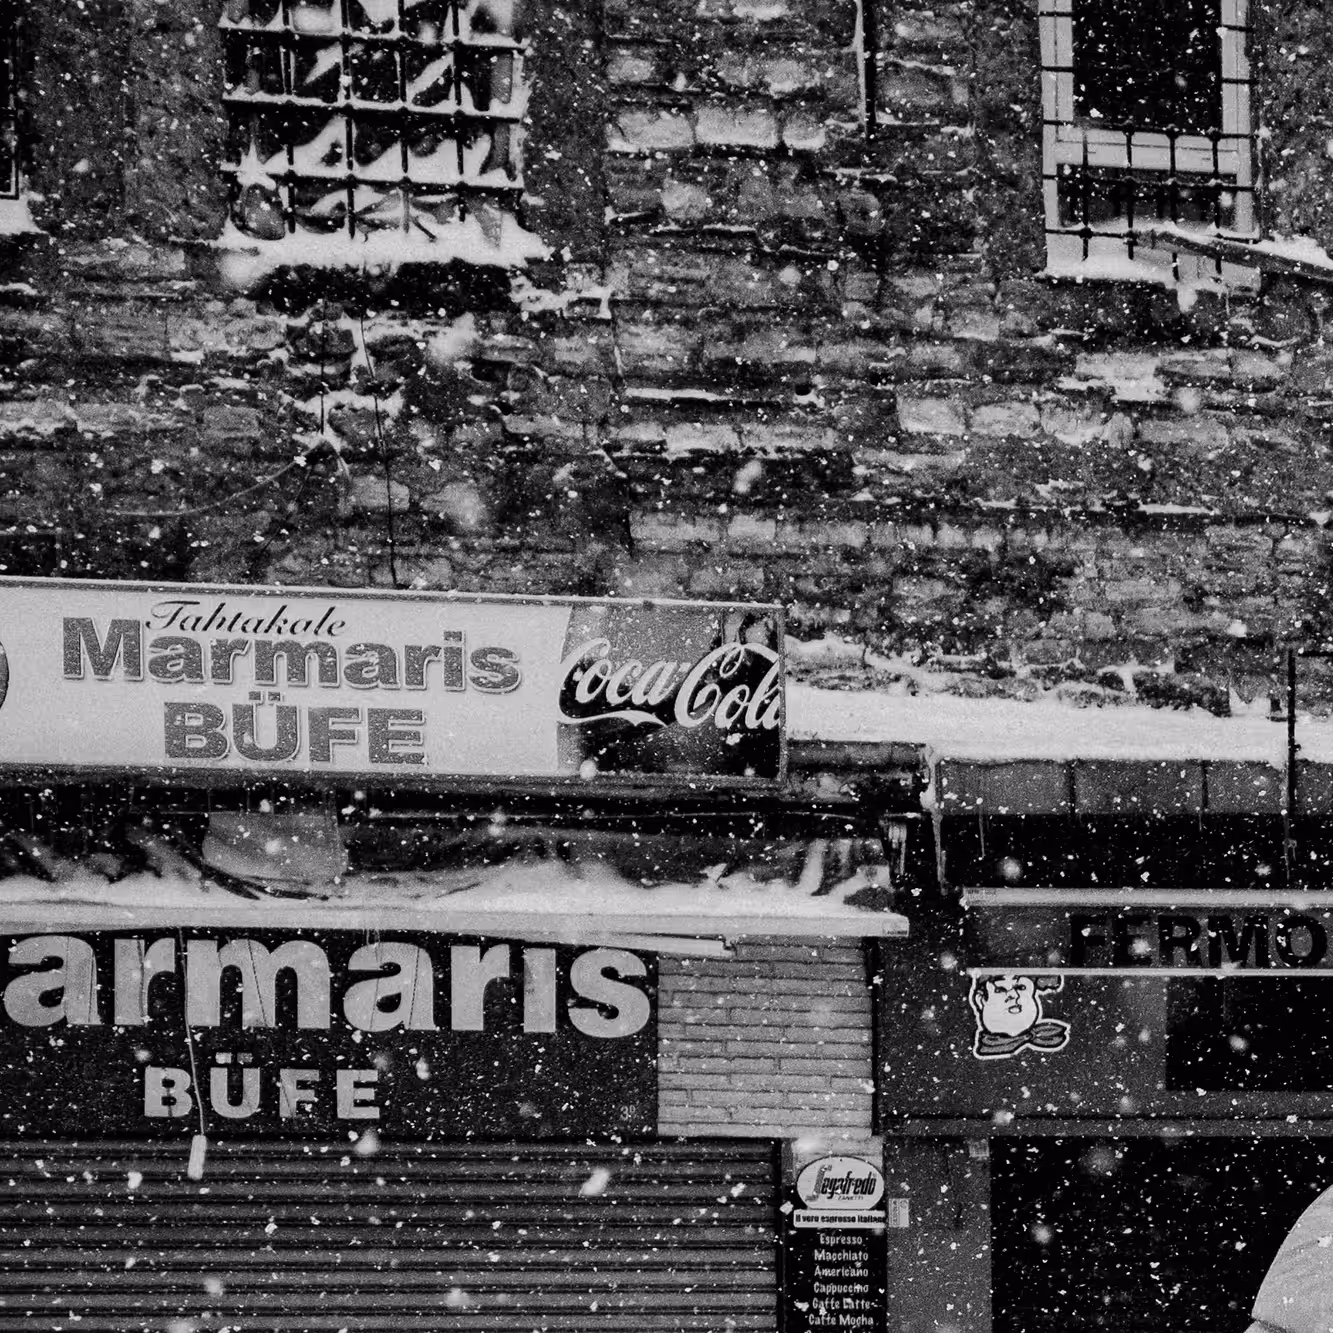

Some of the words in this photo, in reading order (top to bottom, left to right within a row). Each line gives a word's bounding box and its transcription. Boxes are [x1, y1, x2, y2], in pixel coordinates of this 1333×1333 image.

[145, 600, 346, 636] Tahtakale
[62, 616, 522, 694] Marmaris
[163, 690, 427, 765] BÜFE
[1069, 914, 1328, 968] FERMO
[3, 935, 651, 1038] armaris
[144, 1052, 381, 1119] BÜFE
[805, 1164, 877, 1199] Segafredo
[814, 1249, 869, 1261] Macchiato
[819, 1234, 863, 1247] Espresso
[813, 1281, 869, 1295] Cappuccino
[814, 1265, 869, 1277] Americano
[839, 1313, 874, 1326] Mocha
[842, 1297, 870, 1309] Latte
